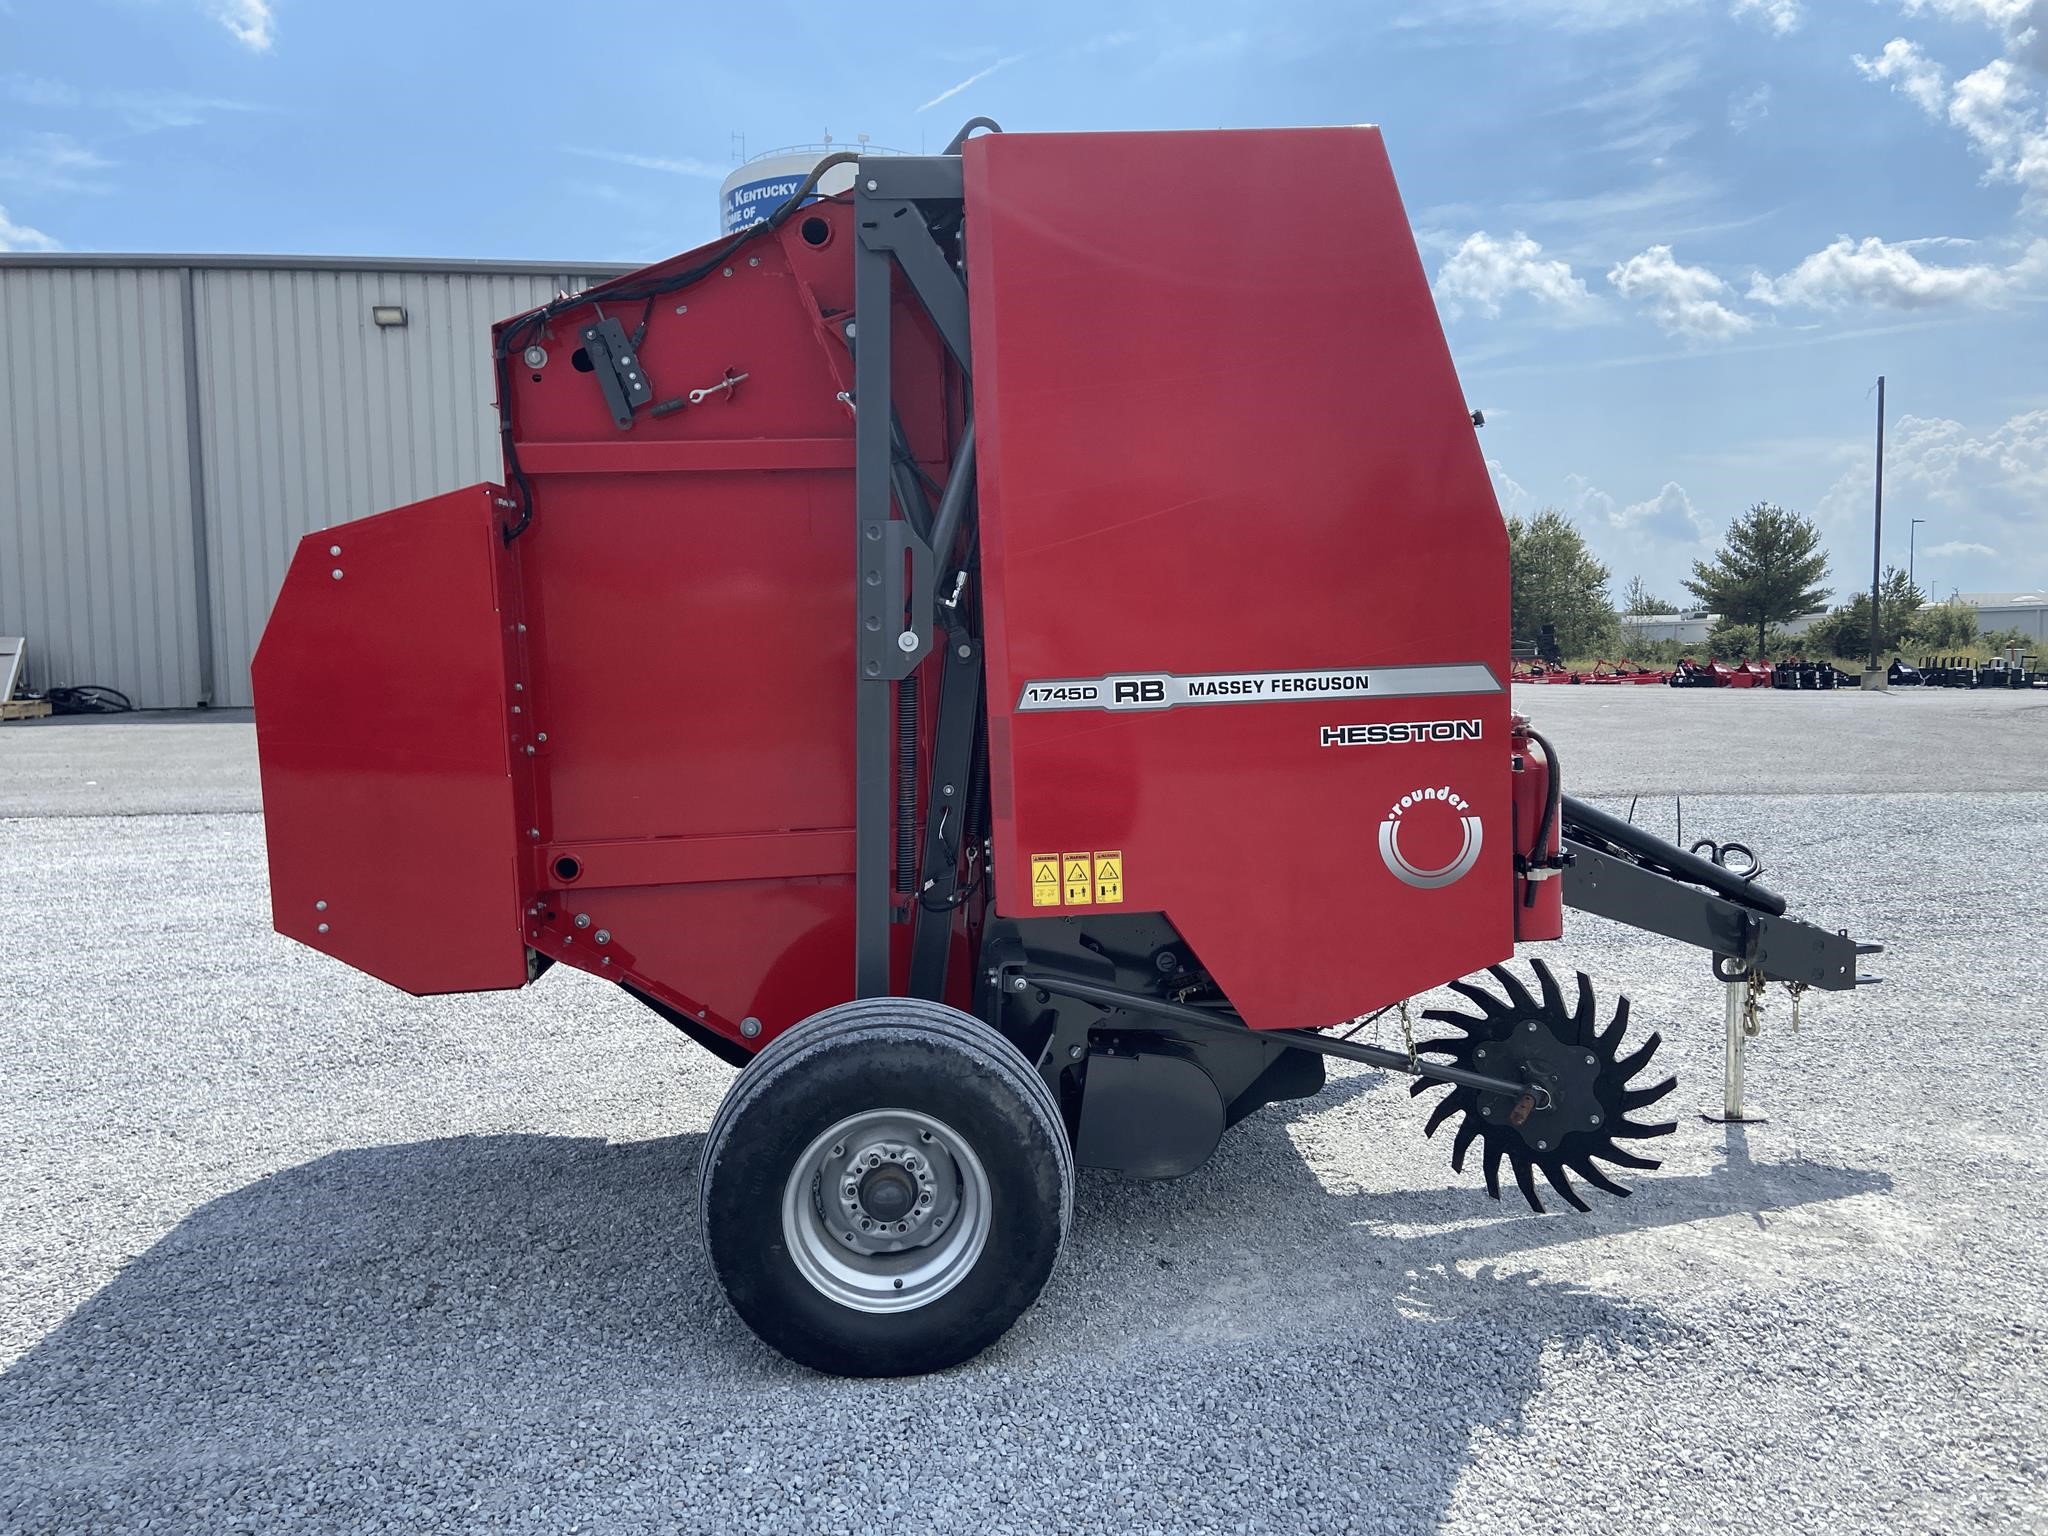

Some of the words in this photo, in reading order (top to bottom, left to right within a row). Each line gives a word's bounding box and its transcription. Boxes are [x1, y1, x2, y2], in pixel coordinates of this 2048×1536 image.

[735, 183, 797, 207] KENTUCKY
[743, 206, 756, 219] OF
[1028, 687, 1098, 701] 1745D
[1114, 680, 1165, 703] RB
[1188, 680, 1264, 696] MASSEY
[1271, 675, 1369, 693] FERGUSON
[1321, 720, 1482, 747] HESSTON
